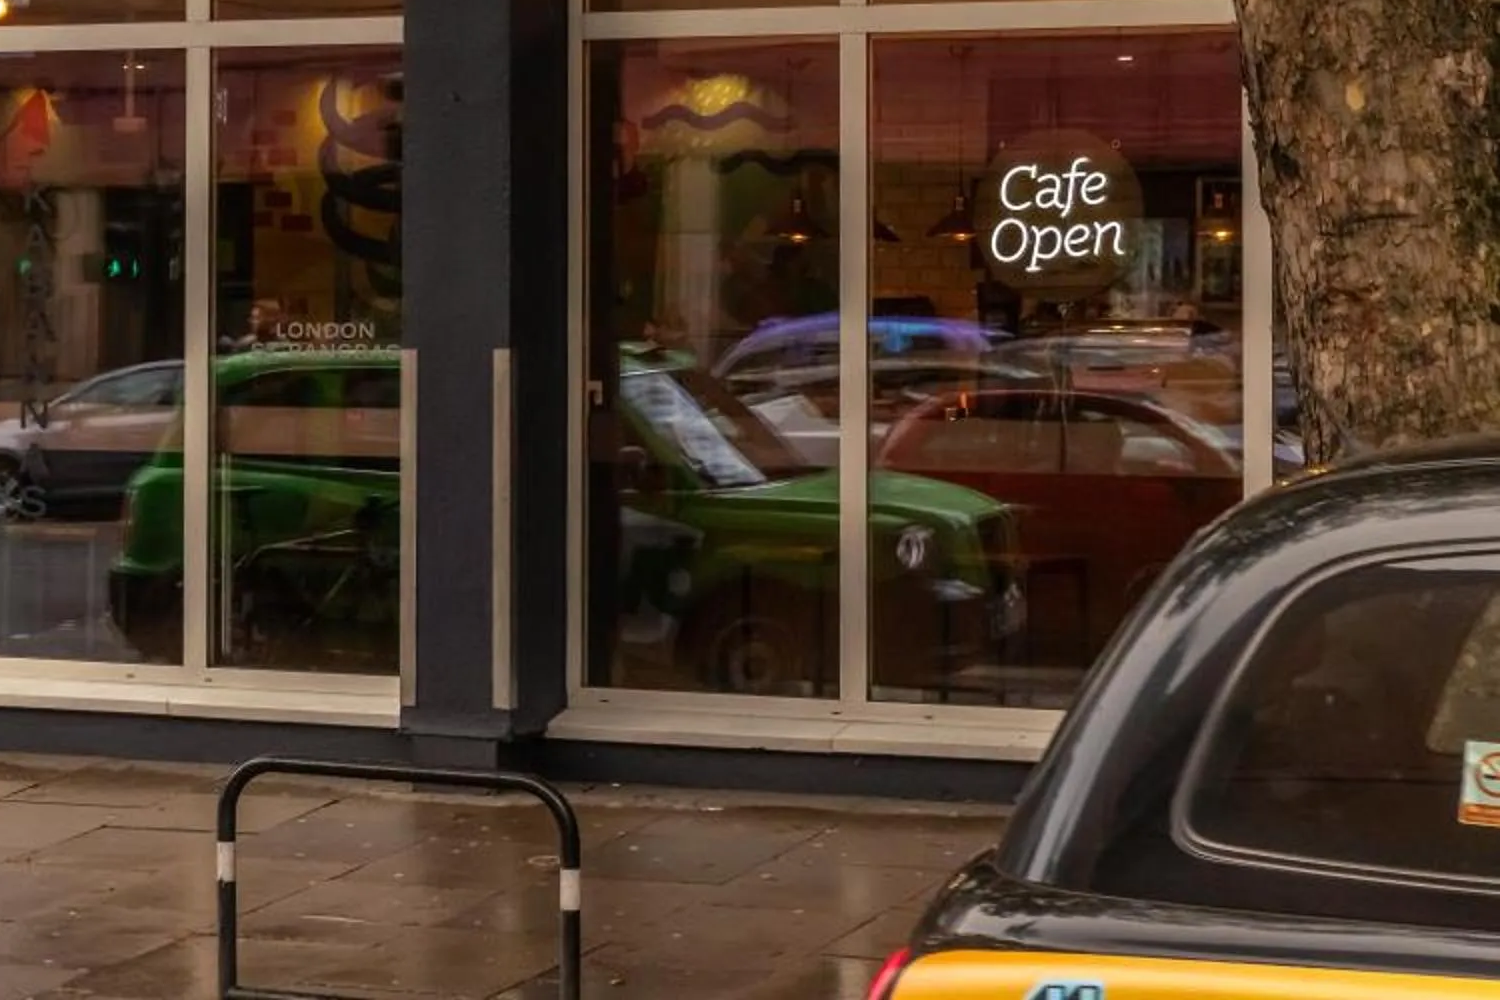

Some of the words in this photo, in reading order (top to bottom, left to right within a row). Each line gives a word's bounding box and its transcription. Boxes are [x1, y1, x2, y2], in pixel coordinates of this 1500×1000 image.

[1001, 156, 1107, 217] Cafe
[991, 218, 1124, 272] Open
[276, 322, 376, 339] LONDON
